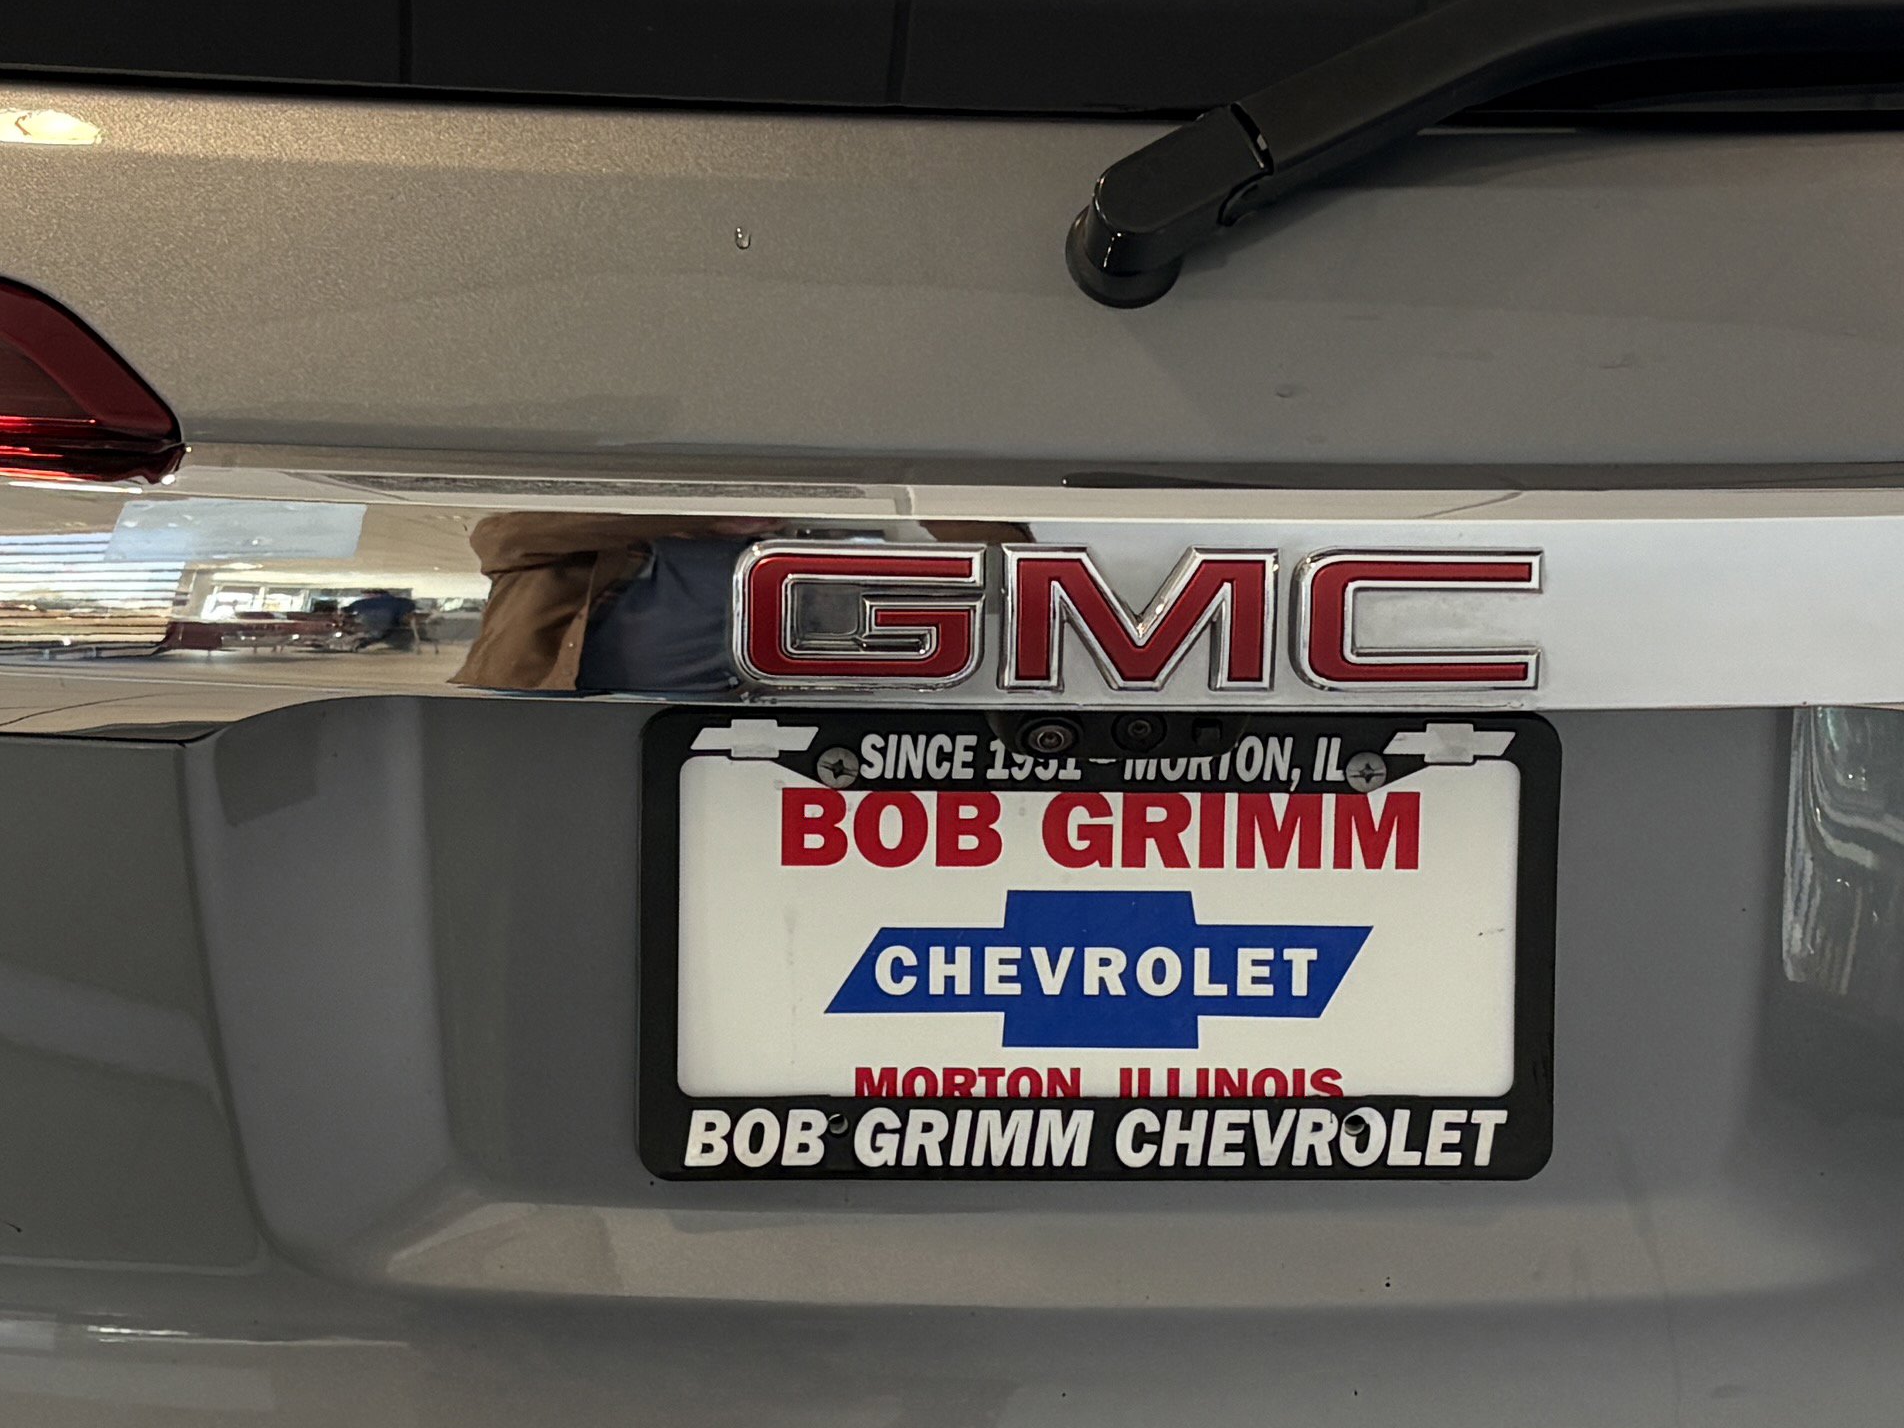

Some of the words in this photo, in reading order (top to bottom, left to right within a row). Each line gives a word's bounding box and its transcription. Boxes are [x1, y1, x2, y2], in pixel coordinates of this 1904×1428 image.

[734, 540, 1545, 693] GMC
[859, 733, 976, 781] SINCE
[1312, 736, 1345, 782] IL
[779, 790, 1003, 869] BOB
[1042, 790, 1422, 871] GRIMM
[874, 943, 1320, 998] CHEVROLET
[683, 1108, 829, 1168] BOB
[853, 1107, 1091, 1168] GRIMM
[1114, 1106, 1509, 1168] CHEVROLET
